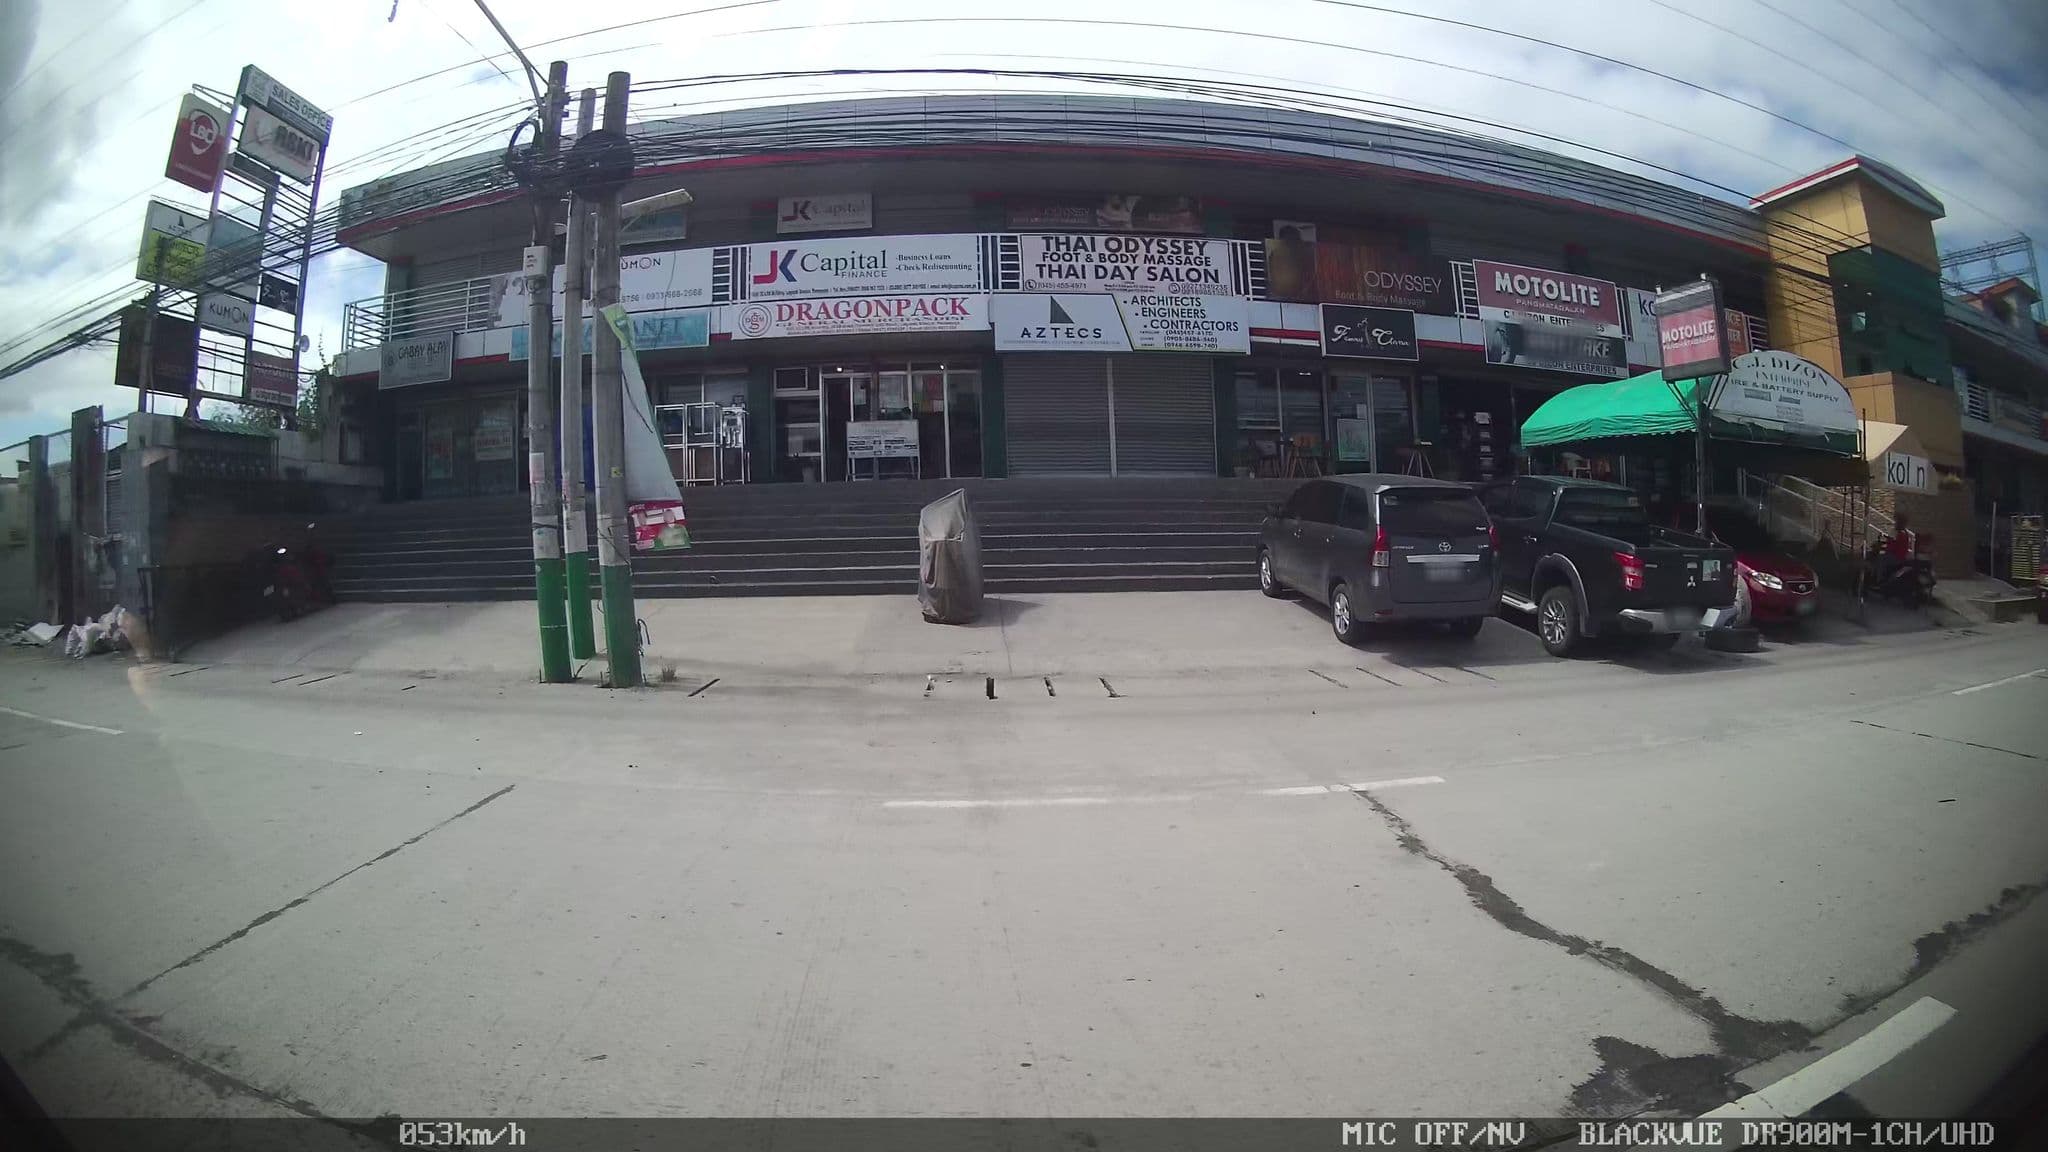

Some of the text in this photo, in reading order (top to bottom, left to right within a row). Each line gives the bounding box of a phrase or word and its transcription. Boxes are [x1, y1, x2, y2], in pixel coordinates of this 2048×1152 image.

[271, 84, 300, 112] SALES
[301, 104, 333, 130] OFFICE
[190, 121, 215, 144] LBC
[782, 200, 811, 221] JK
[1042, 236, 1208, 256] THAI ODYSSEY
[621, 257, 661, 270] UMON
[753, 249, 888, 285] JK Capital
[1042, 252, 1211, 267] FOOT & BODY MASSAGE
[841, 269, 888, 279] FINANCE
[1036, 264, 1219, 283] THAI DAY SALON
[1364, 270, 1442, 293] ODYSSEY
[1495, 271, 1600, 307] MOTOLITE
[776, 297, 971, 322] DRAGONPACK
[1131, 295, 1202, 307] ARCHITECTS
[209, 302, 250, 323] KUMON
[1141, 307, 1206, 319] ENGINEERS
[1020, 327, 1102, 339] AZTECS
[1150, 320, 1239, 331] CONTRACTORS
[1662, 320, 1715, 344] MOTOLITE
[1771, 357, 1828, 387] DIZON
[1761, 383, 1804, 395] BATTERY
[1807, 391, 1840, 402] SUPPLY
